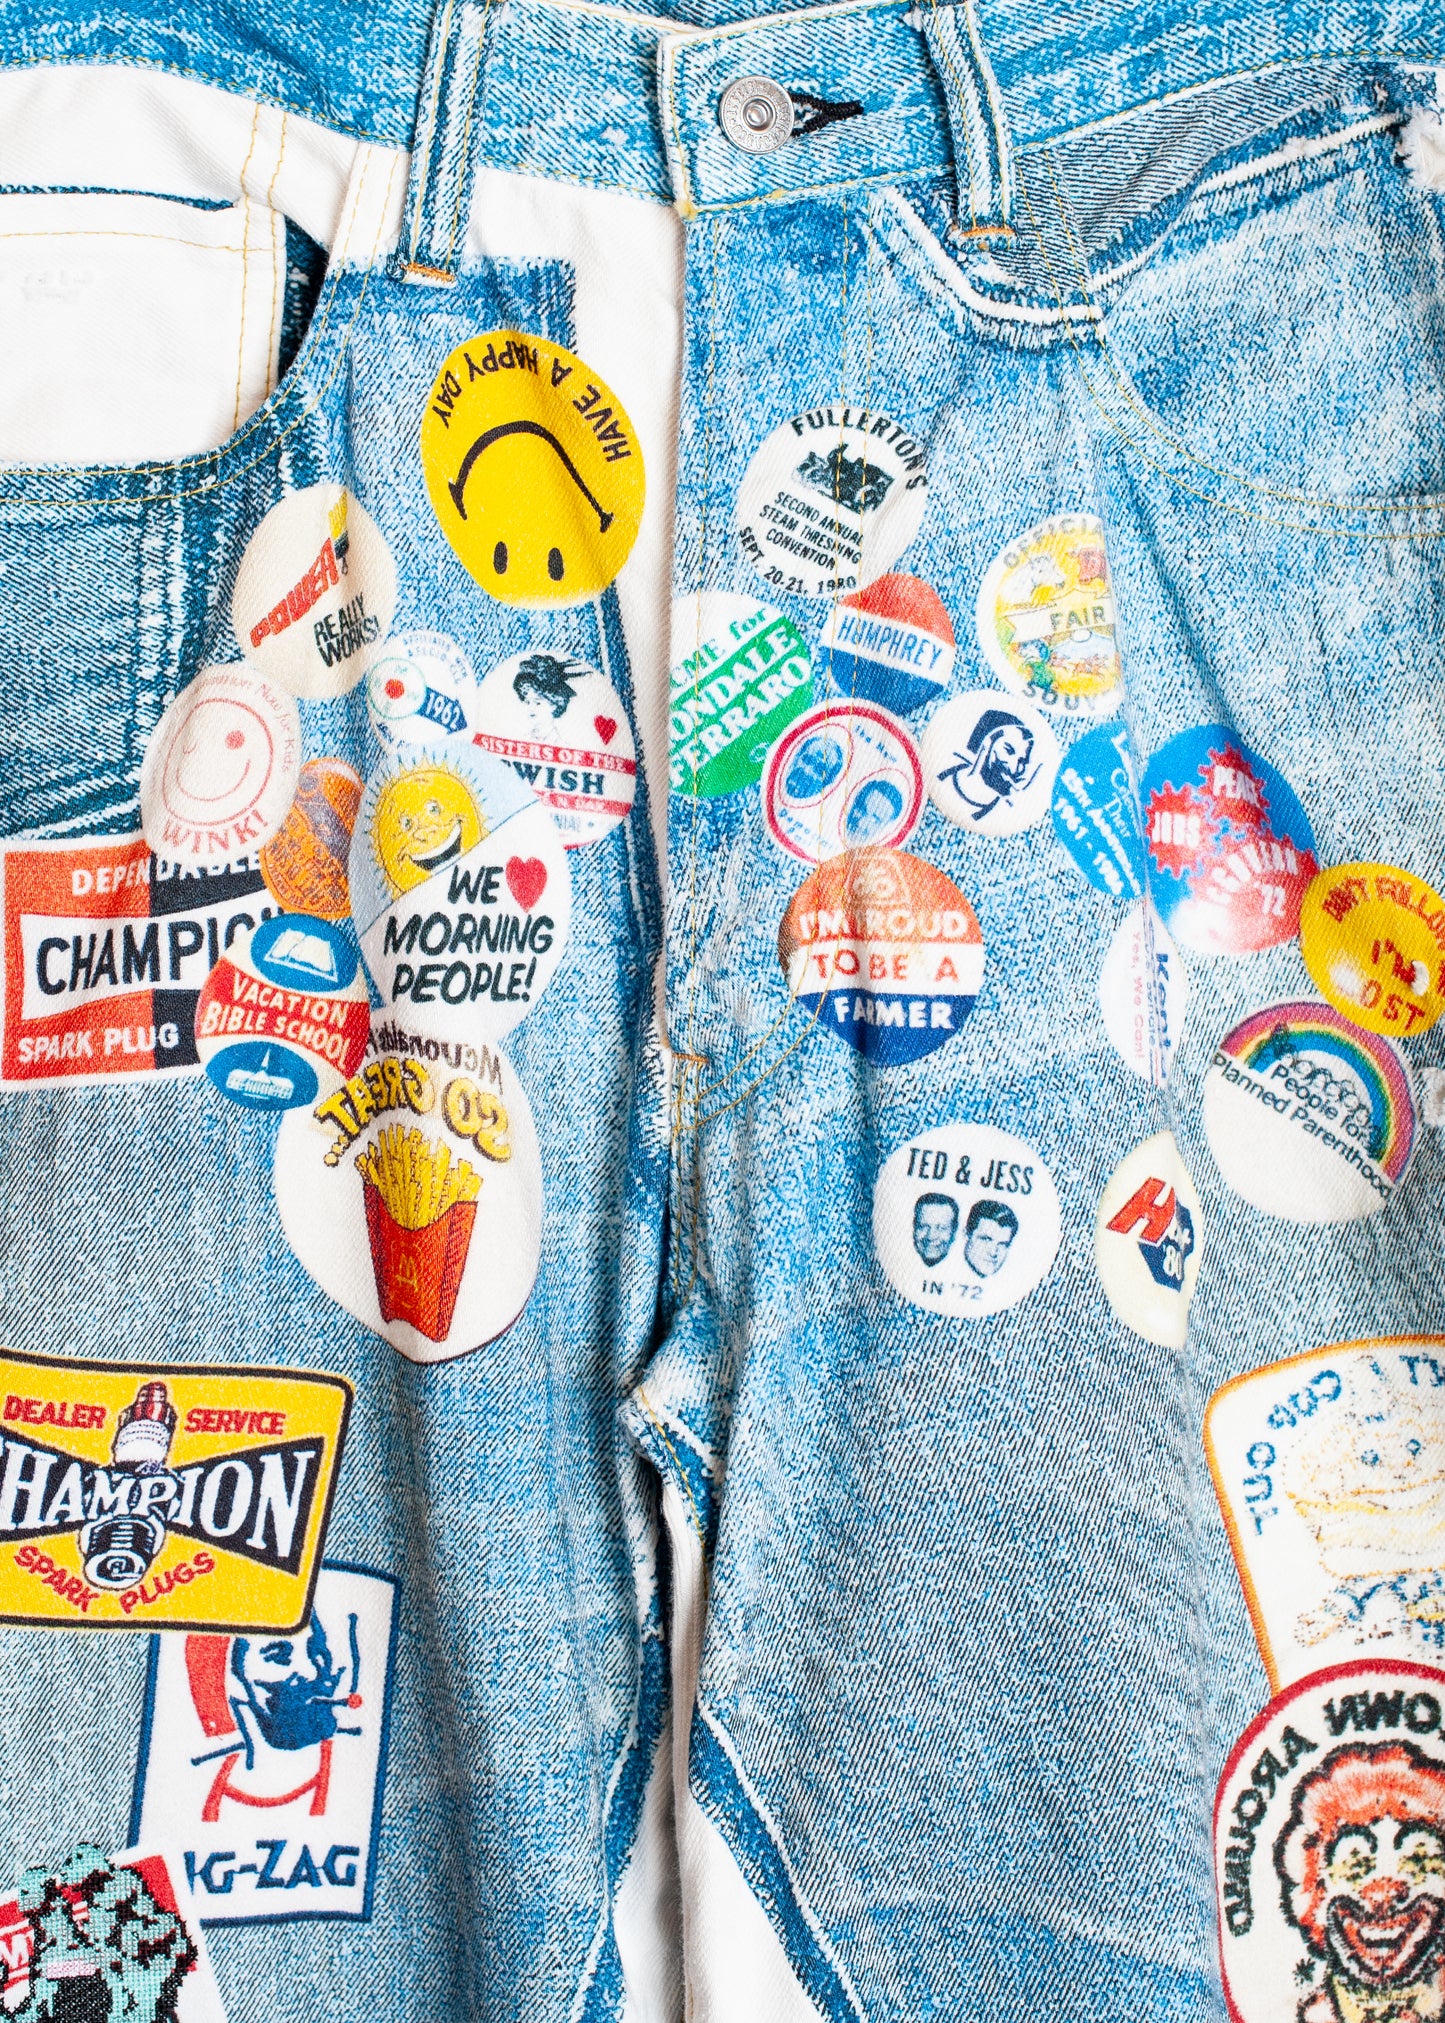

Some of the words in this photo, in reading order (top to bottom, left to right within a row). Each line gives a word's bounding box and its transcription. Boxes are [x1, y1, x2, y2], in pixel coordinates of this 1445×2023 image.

[463, 340, 539, 383] HAPPY
[550, 358, 573, 388] A
[431, 370, 463, 429] DAY
[572, 383, 632, 462] HAVE
[759, 505, 799, 532] STEAM
[801, 525, 862, 564] THRESHING
[775, 491, 820, 522] SECOND
[819, 515, 863, 547] ANNUAL
[739, 526, 764, 568] SEPT.
[766, 528, 836, 571] CONVENTION
[314, 592, 366, 646] REALLY
[317, 615, 382, 667] WORKS!
[729, 608, 768, 641] for
[1051, 606, 1106, 632] FAIR
[837, 615, 942, 670] HUMPHREY
[669, 626, 800, 744] ONDALE
[427, 693, 460, 731] 1962
[480, 735, 556, 762] SISTERS
[558, 745, 587, 767] OF
[590, 750, 627, 773] THE
[500, 757, 605, 796] WISH
[162, 808, 269, 854] WINK!
[447, 865, 503, 904] WE
[383, 911, 555, 956] MORNING
[800, 908, 846, 939] I'M
[392, 956, 538, 1005] PEOPLE!
[812, 949, 860, 979] TO
[869, 954, 909, 980] BE
[935, 955, 960, 982] A
[233, 968, 348, 1029] VACATION
[834, 996, 955, 1029] FARMER
[1132, 976, 1144, 1007] We
[1358, 977, 1425, 1031] OST
[17, 1028, 94, 1063] SPARK
[101, 1023, 179, 1055] PLUG
[201, 1003, 266, 1034] BIBLE
[276, 1017, 351, 1070] SCHOOL
[1212, 1051, 1289, 1115] Planned
[1290, 1107, 1393, 1199] Parenthood
[1270, 1062, 1338, 1121] People
[1339, 1115, 1370, 1149] for
[906, 1148, 948, 1180] TED
[955, 1155, 971, 1185] &
[980, 1159, 1034, 1195] JESS
[951, 1282, 983, 1300] '72
[3, 1395, 107, 1429] DEALER
[184, 1408, 286, 1435] SERVICE
[0, 1440, 316, 1558] HAMPION
[14, 1544, 100, 1613] SPARK
[119, 1551, 216, 1613] PLUGS
[183, 1839, 360, 1895] IG-ZAG
